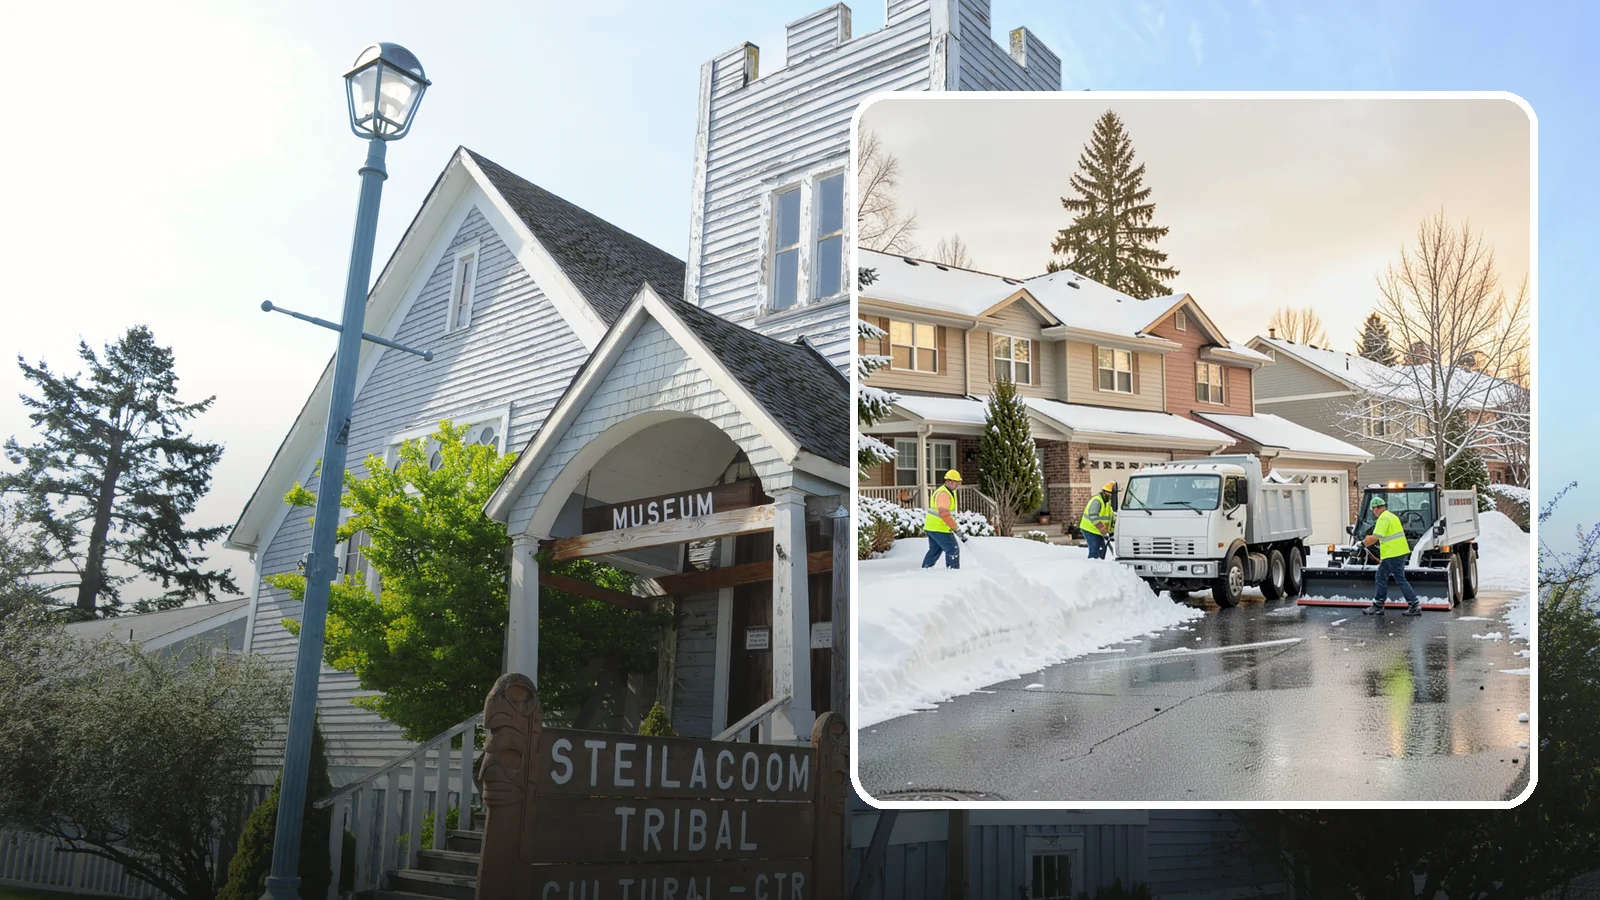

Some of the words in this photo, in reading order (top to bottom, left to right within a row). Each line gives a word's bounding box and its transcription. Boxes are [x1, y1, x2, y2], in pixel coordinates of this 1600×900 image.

[613, 491, 713, 531] MUSEUM
[550, 738, 810, 793] STEILACOOM
[615, 806, 758, 852] TRIBAL
